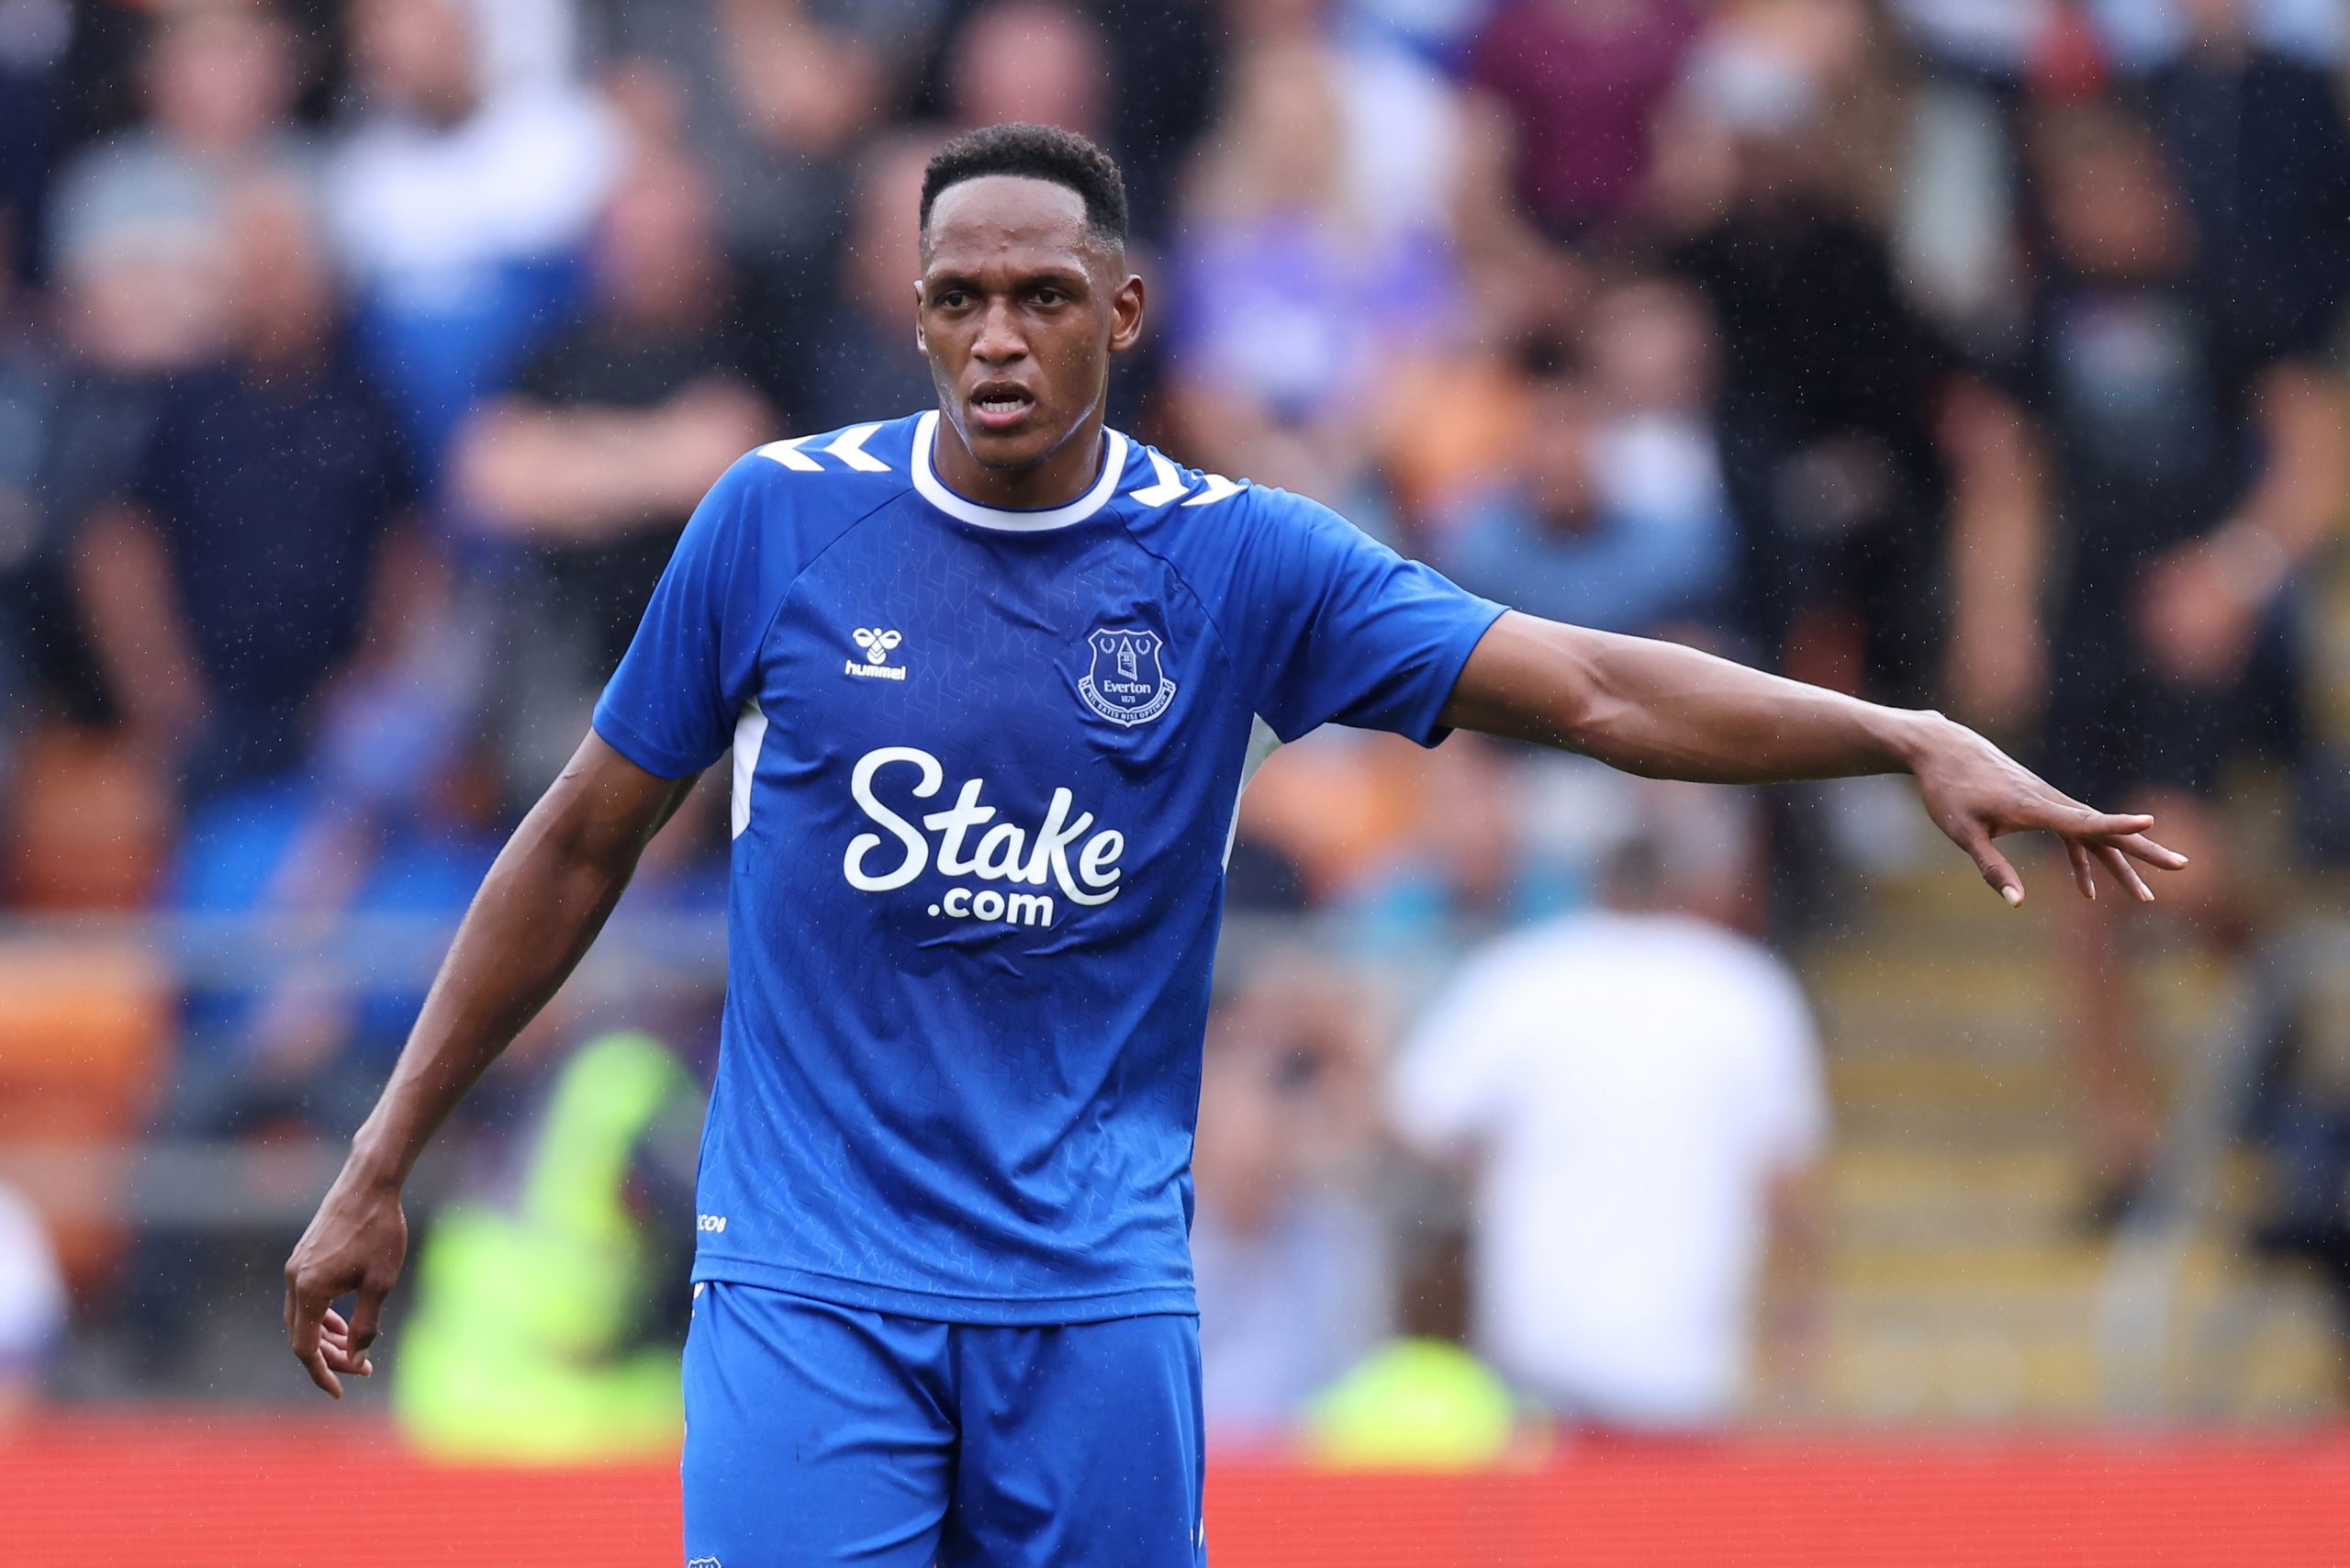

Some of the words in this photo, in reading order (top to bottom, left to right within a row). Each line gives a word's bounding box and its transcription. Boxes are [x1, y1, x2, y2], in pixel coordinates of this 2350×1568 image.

[845, 659, 906, 681] hummel
[1103, 679, 1152, 694] Everton
[1121, 695, 1136, 704] 1878
[1086, 690, 1097, 706] NIL
[1097, 701, 1120, 719] SATIS
[1120, 712, 1138, 721] NISI
[844, 746, 1125, 906] Stake
[927, 887, 1055, 928] .com
